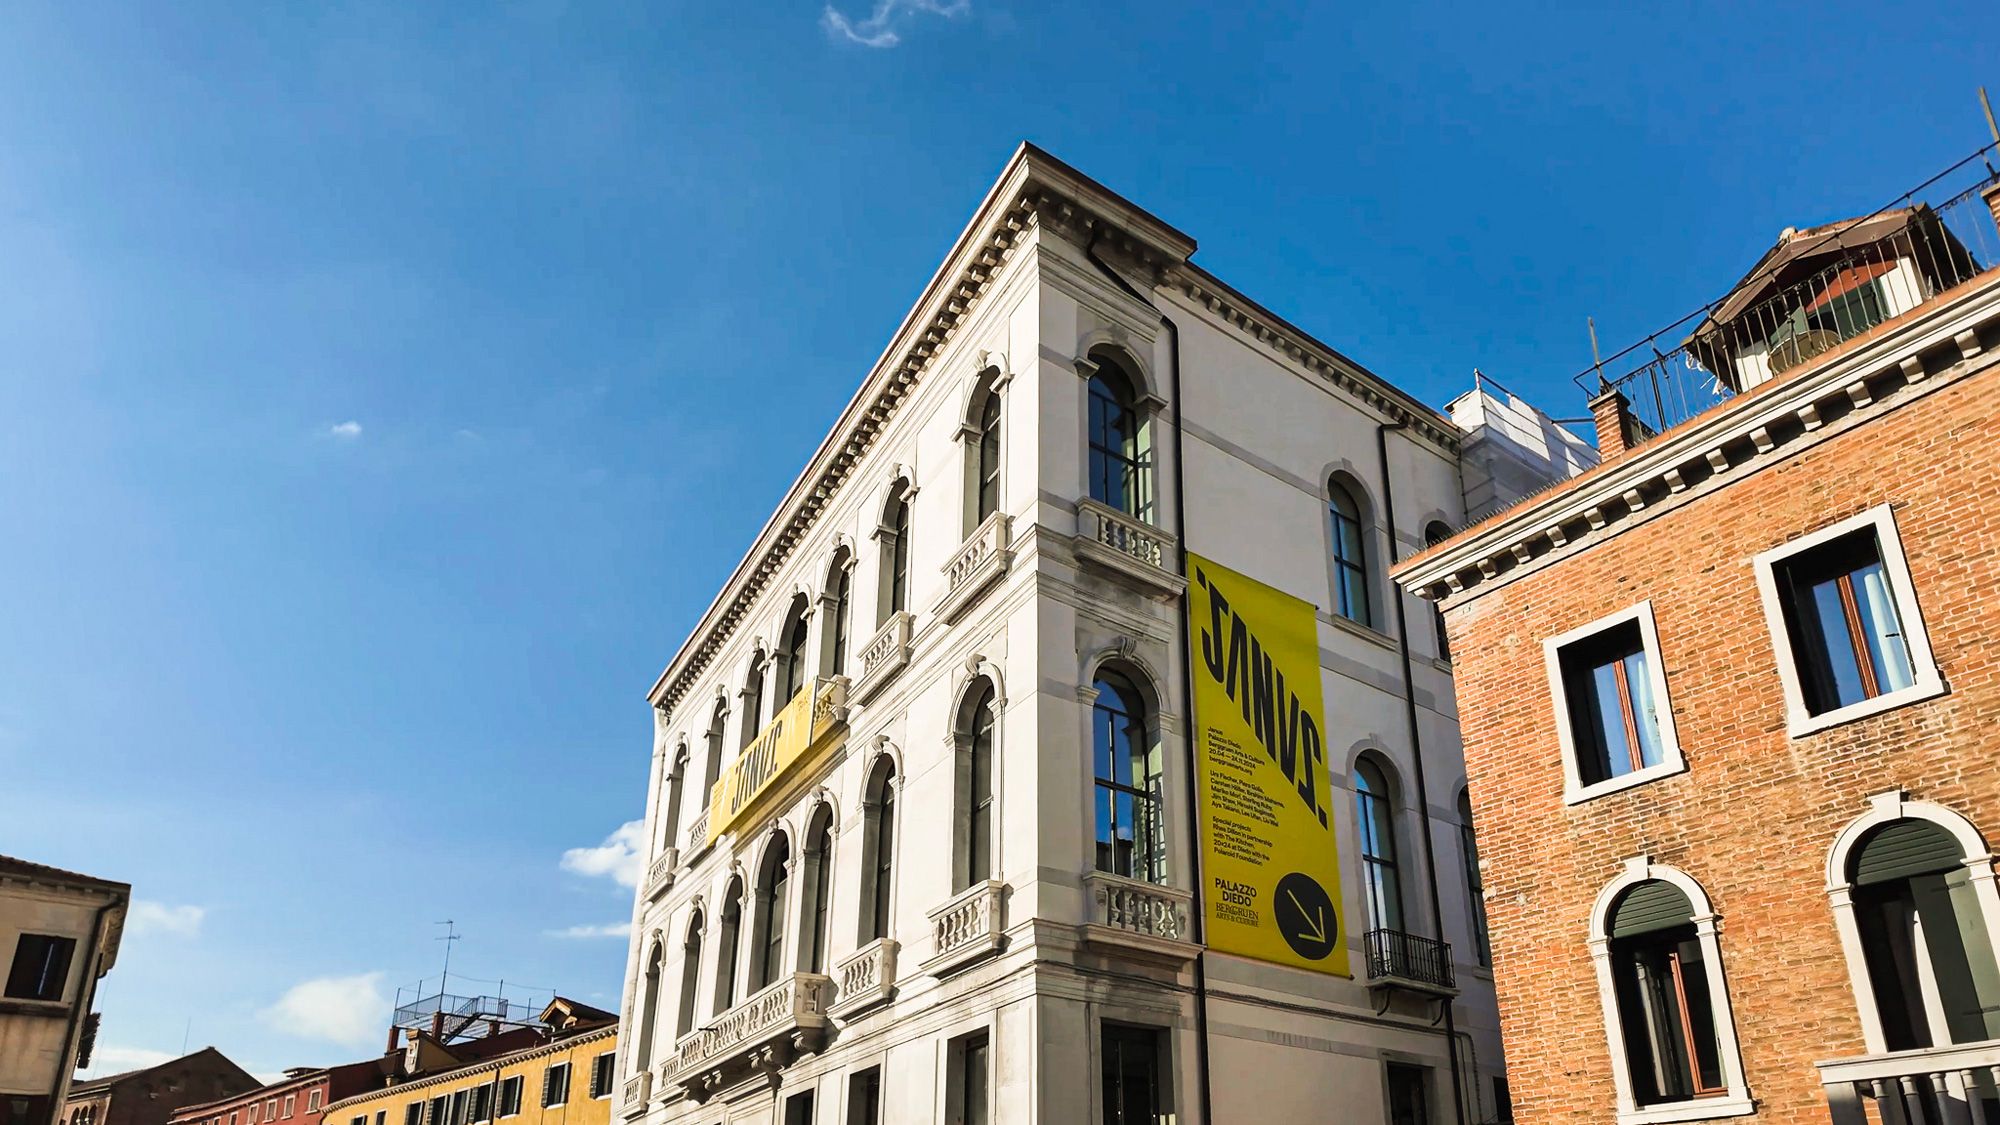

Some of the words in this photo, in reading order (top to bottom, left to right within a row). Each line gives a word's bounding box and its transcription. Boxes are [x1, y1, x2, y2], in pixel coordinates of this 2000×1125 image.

[1207, 726, 1223, 735] Janus
[1215, 877, 1257, 898] PALAZZO
[1222, 890, 1252, 907] DIEDO
